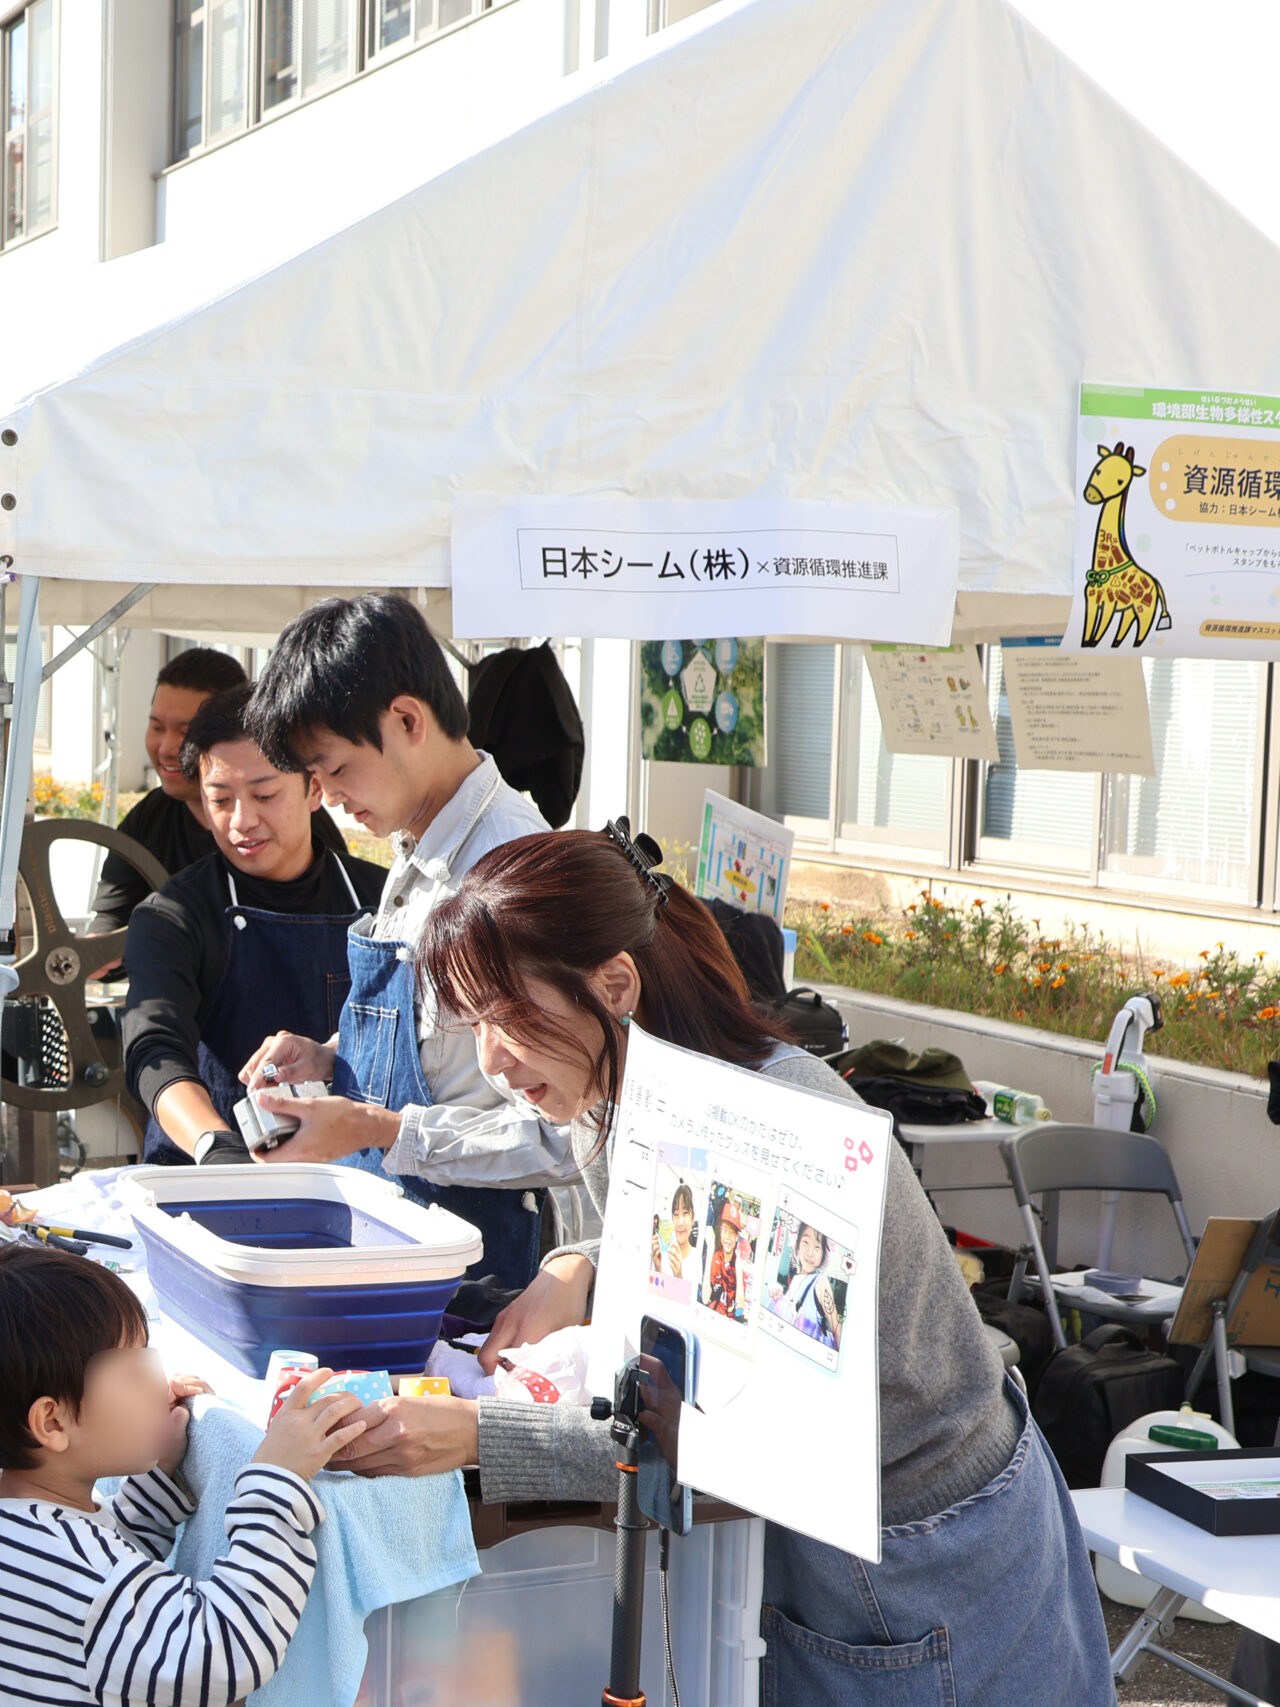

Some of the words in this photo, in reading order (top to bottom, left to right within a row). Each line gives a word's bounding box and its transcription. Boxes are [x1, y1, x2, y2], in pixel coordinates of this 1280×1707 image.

[773, 557, 889, 581] 資源循環推進課
